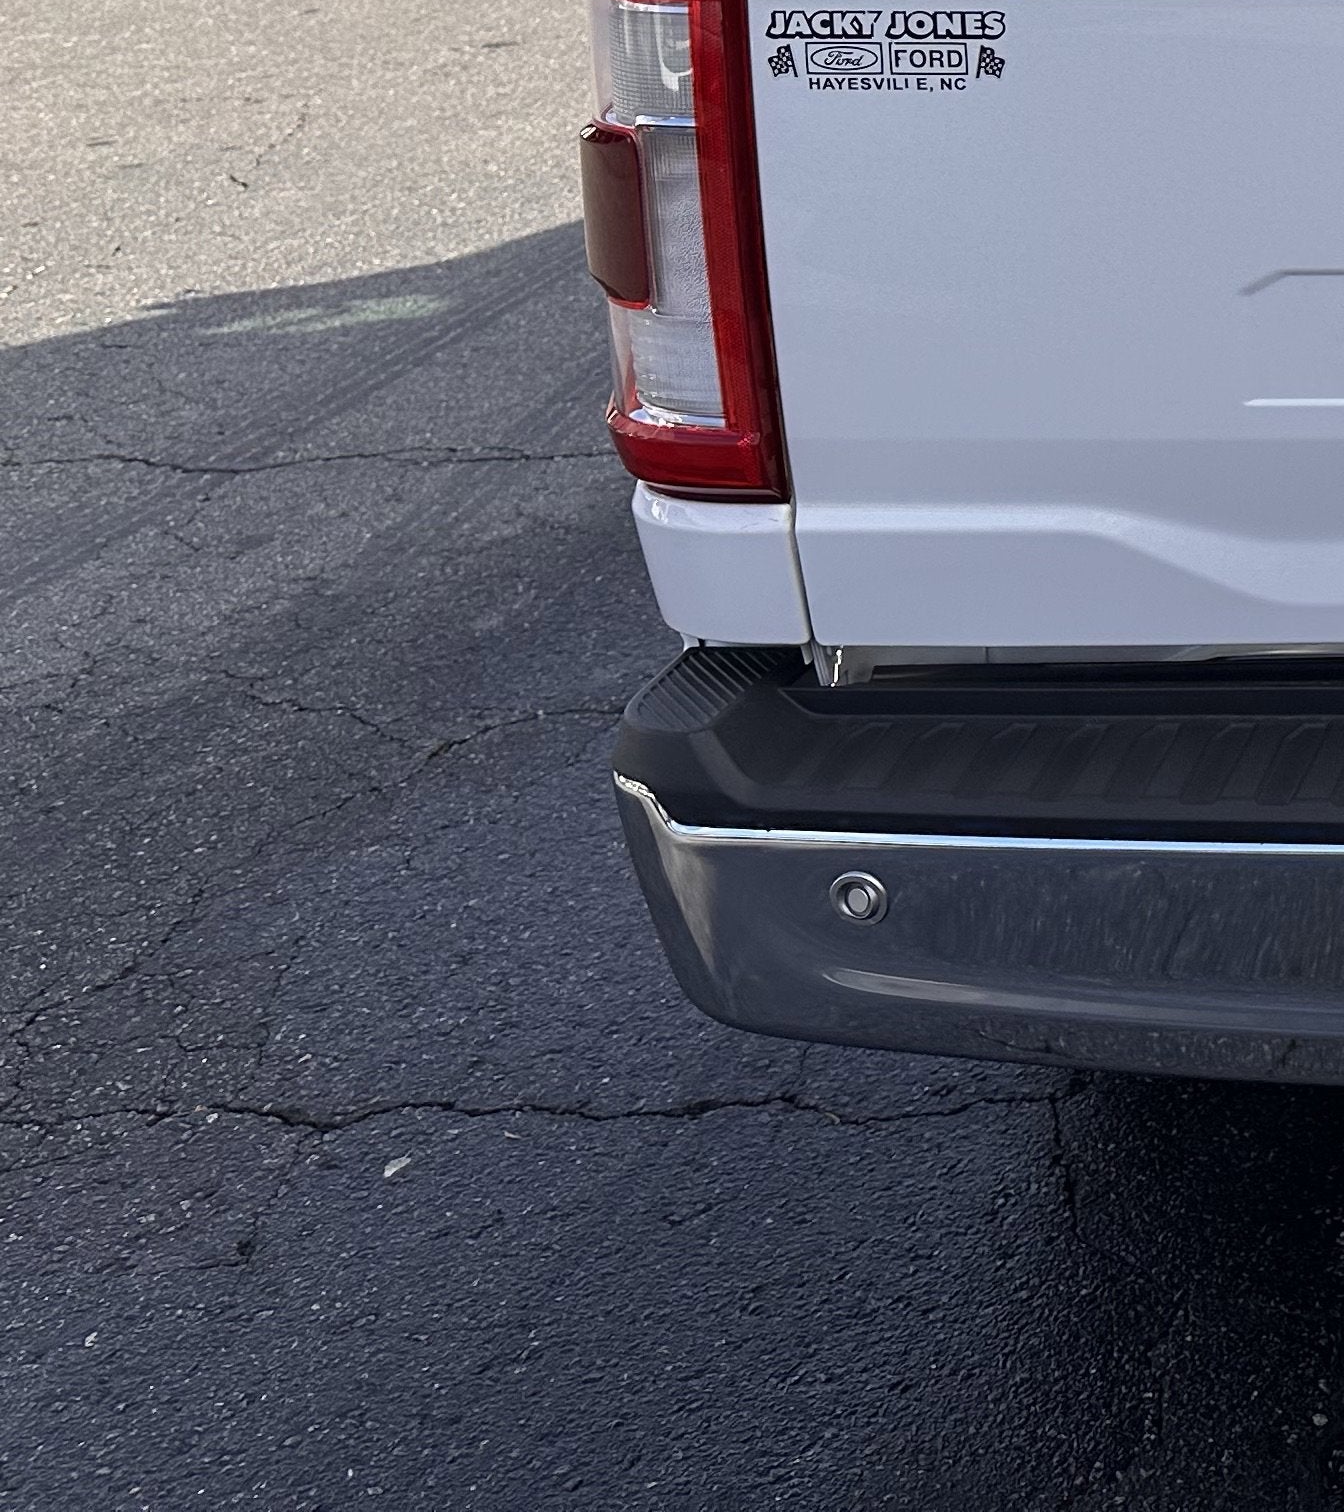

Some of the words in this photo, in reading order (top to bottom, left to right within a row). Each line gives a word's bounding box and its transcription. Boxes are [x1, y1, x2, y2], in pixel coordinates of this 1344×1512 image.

[766, 11, 882, 38] JACKY
[885, 11, 1005, 39] JONES
[824, 50, 863, 67] Ford
[894, 49, 963, 68] FORD
[940, 77, 967, 91] NC
